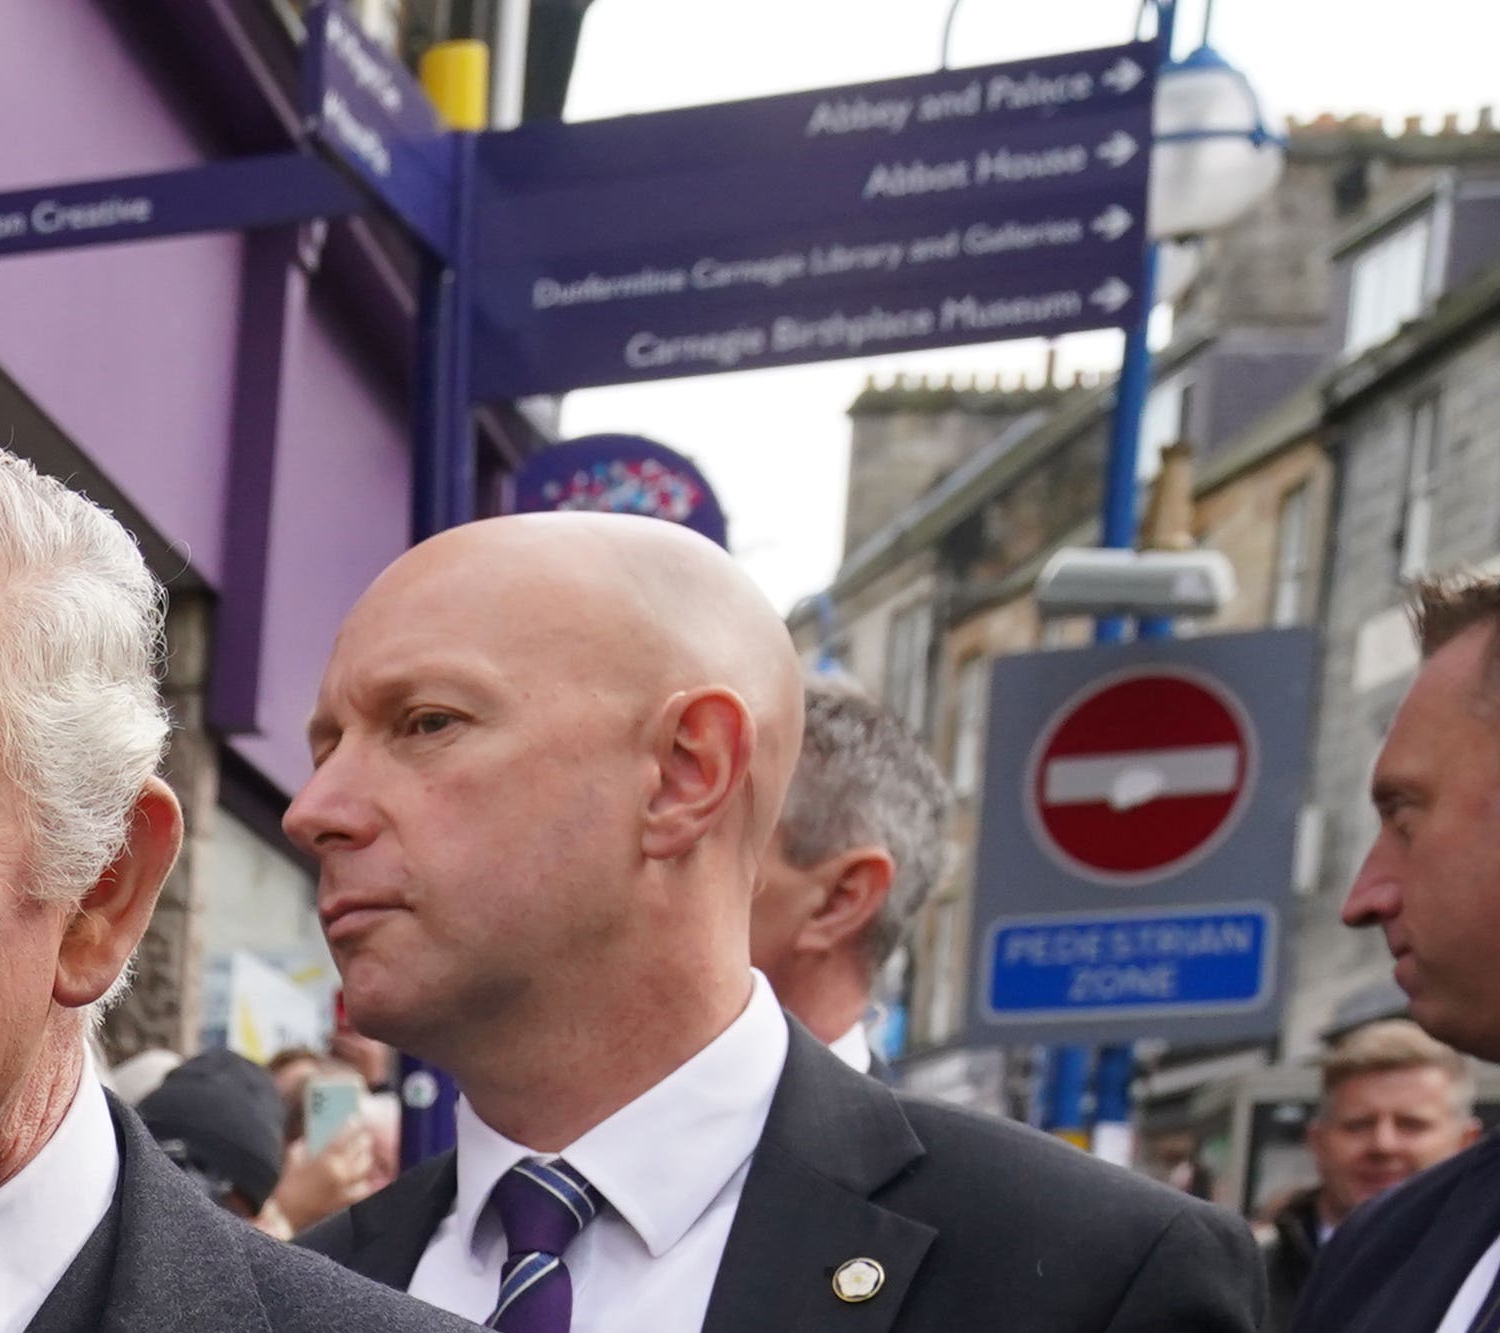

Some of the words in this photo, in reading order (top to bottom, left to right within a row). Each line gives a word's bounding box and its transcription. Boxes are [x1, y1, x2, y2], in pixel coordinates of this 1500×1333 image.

[807, 97, 913, 136] Abbey
[917, 82, 982, 122] and
[987, 73, 1093, 112] Palace
[861, 157, 970, 199] Abbot
[973, 143, 1088, 186] House
[31, 196, 153, 236] Creative
[533, 270, 686, 308] Dunfermline
[692, 255, 804, 289] Carnegie
[808, 242, 904, 276] Library
[906, 229, 962, 264] and
[964, 220, 1082, 255] Galleries
[626, 327, 765, 367] Carnegie
[771, 304, 936, 351] Birthplace
[939, 290, 1083, 332] Museum
[1002, 920, 1254, 965] PEDESTRIAN
[1068, 963, 1176, 1000] ZONE
